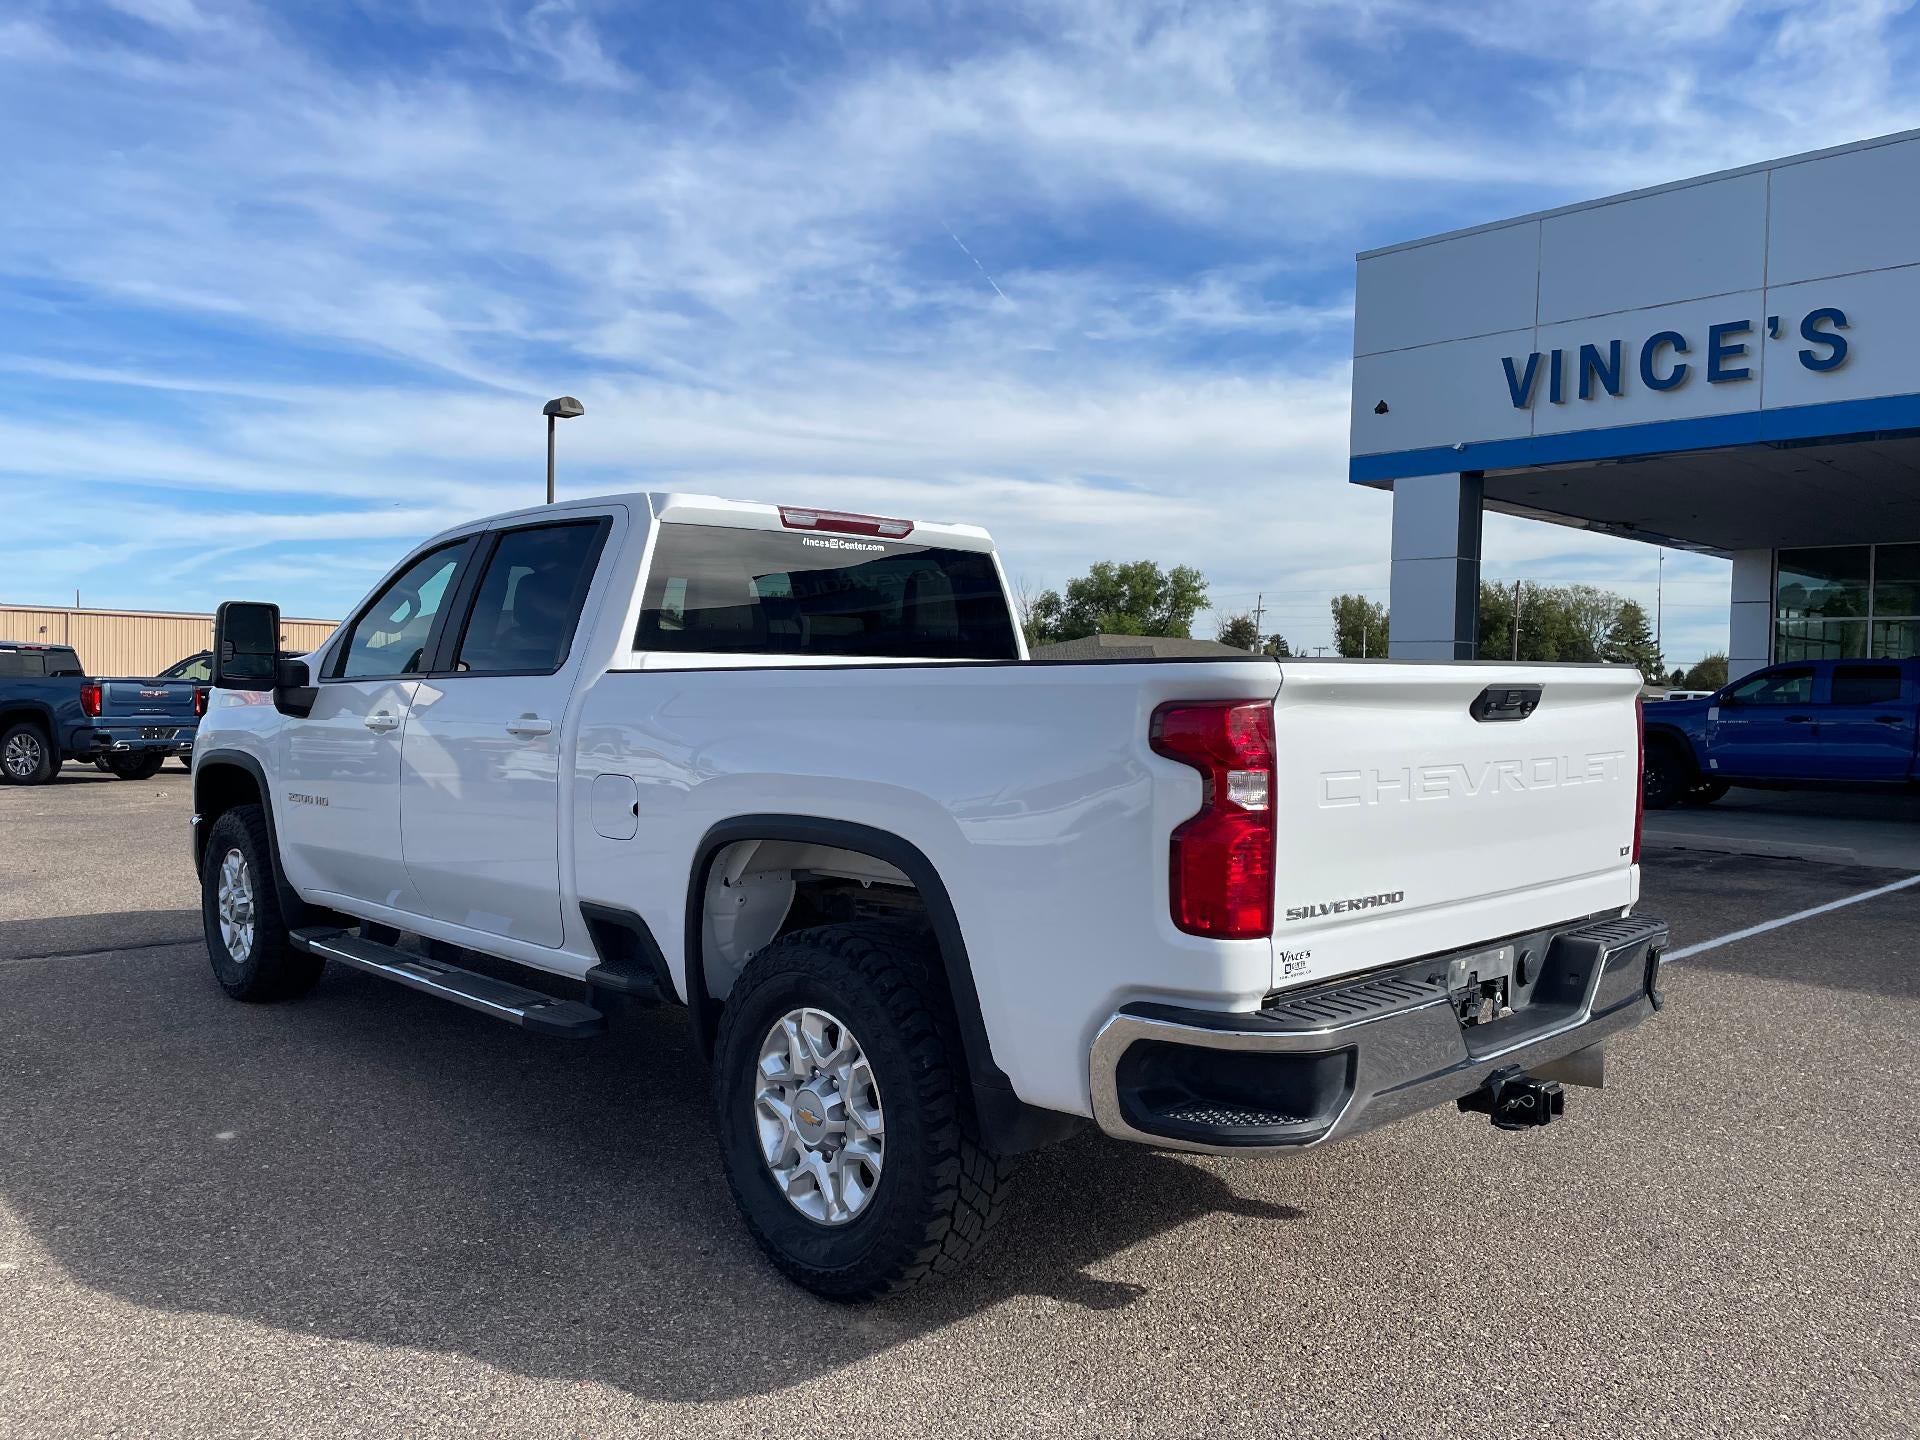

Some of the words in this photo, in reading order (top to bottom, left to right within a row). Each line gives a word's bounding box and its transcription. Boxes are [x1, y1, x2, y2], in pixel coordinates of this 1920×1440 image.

[1501, 307, 1850, 409] VINCE'S
[1319, 750, 1626, 808] CHEVROLET
[1286, 891, 1404, 921] SILVERADO
